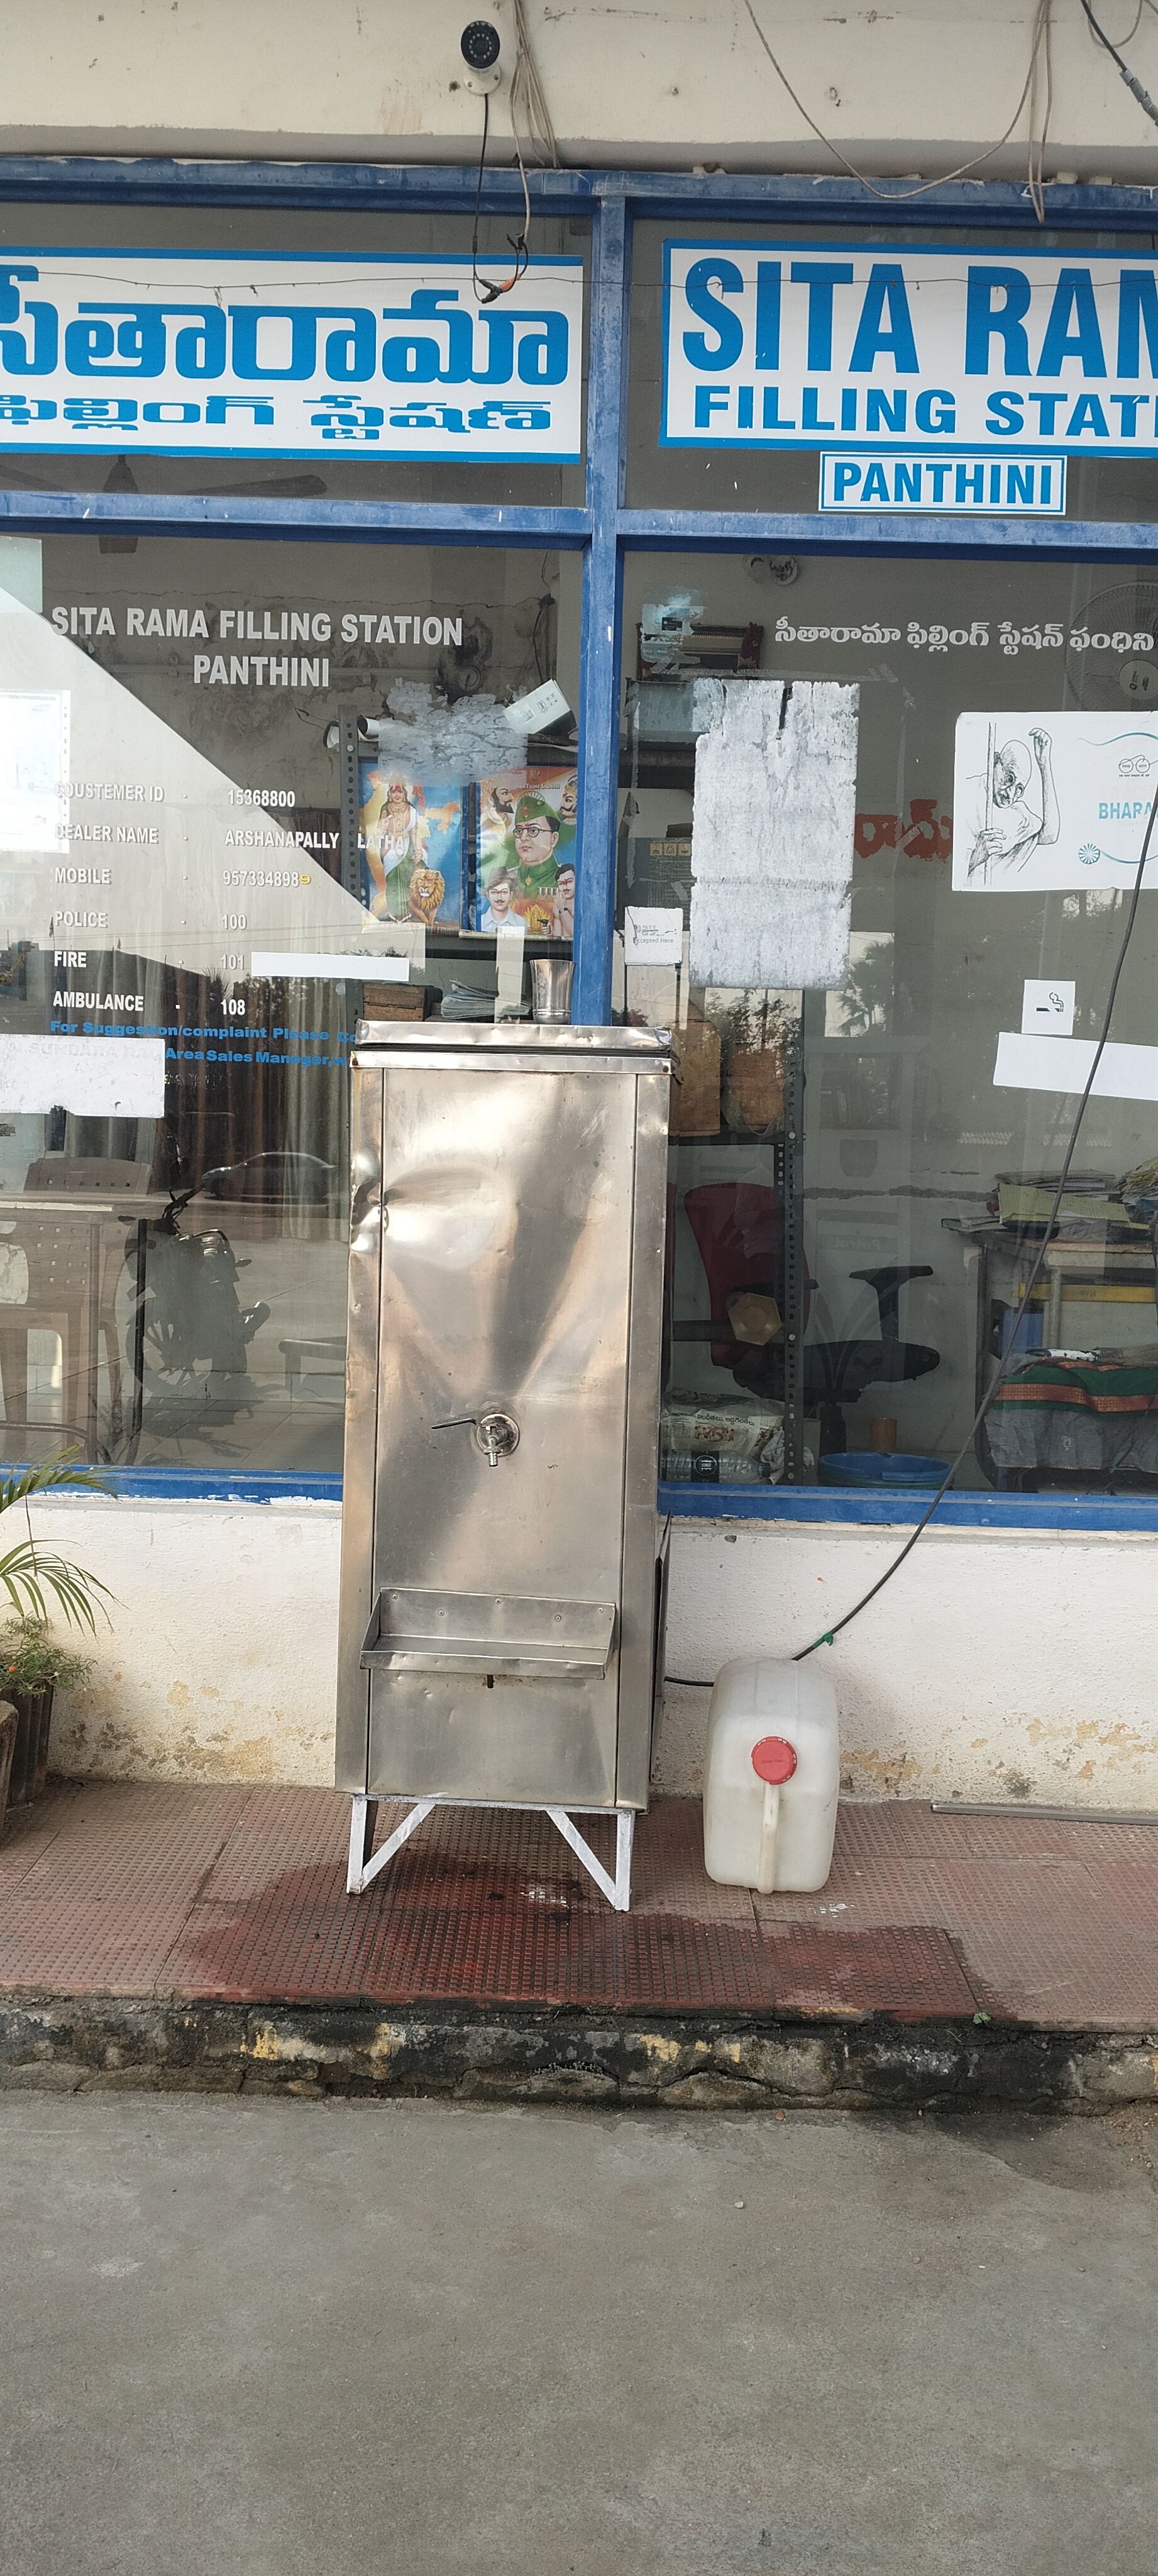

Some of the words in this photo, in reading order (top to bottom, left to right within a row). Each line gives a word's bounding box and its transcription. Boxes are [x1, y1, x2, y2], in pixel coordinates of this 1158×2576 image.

[683, 257, 920, 374] SITA
[695, 385, 957, 434] FILLING
[985, 391, 1158, 438] STAT
[834, 462, 1052, 504] PANTHINI
[52, 606, 116, 636] SITA
[126, 608, 209, 638] RAMA
[219, 610, 331, 642] FILLING
[341, 614, 463, 646] STATION
[775, 616, 902, 643] సీతారామా
[997, 621, 1064, 655] స్టేషన్
[194, 655, 329, 687] PANTHINI
[54, 781, 145, 801] COUSTEMER
[148, 785, 165, 802] ID
[228, 788, 295, 808] 15368800
[55, 823, 112, 841] DEALER
[116, 826, 159, 844] NAME
[224, 829, 340, 849] ARSHANAPALLY
[356, 832, 406, 850] LATHA
[54, 867, 111, 884] MOBILE
[222, 870, 312, 887] 9573348989
[54, 910, 108, 928] POLICE
[221, 913, 247, 930] 100
[53, 950, 87, 968] FIRE
[220, 954, 245, 970] 101
[53, 991, 144, 1012] AMBULANCE
[220, 999, 246, 1016] 108
[50, 1020, 79, 1033] For
[273, 1027, 329, 1041] Please
[164, 1047, 204, 1060] Area
[206, 1050, 253, 1063] Sales
